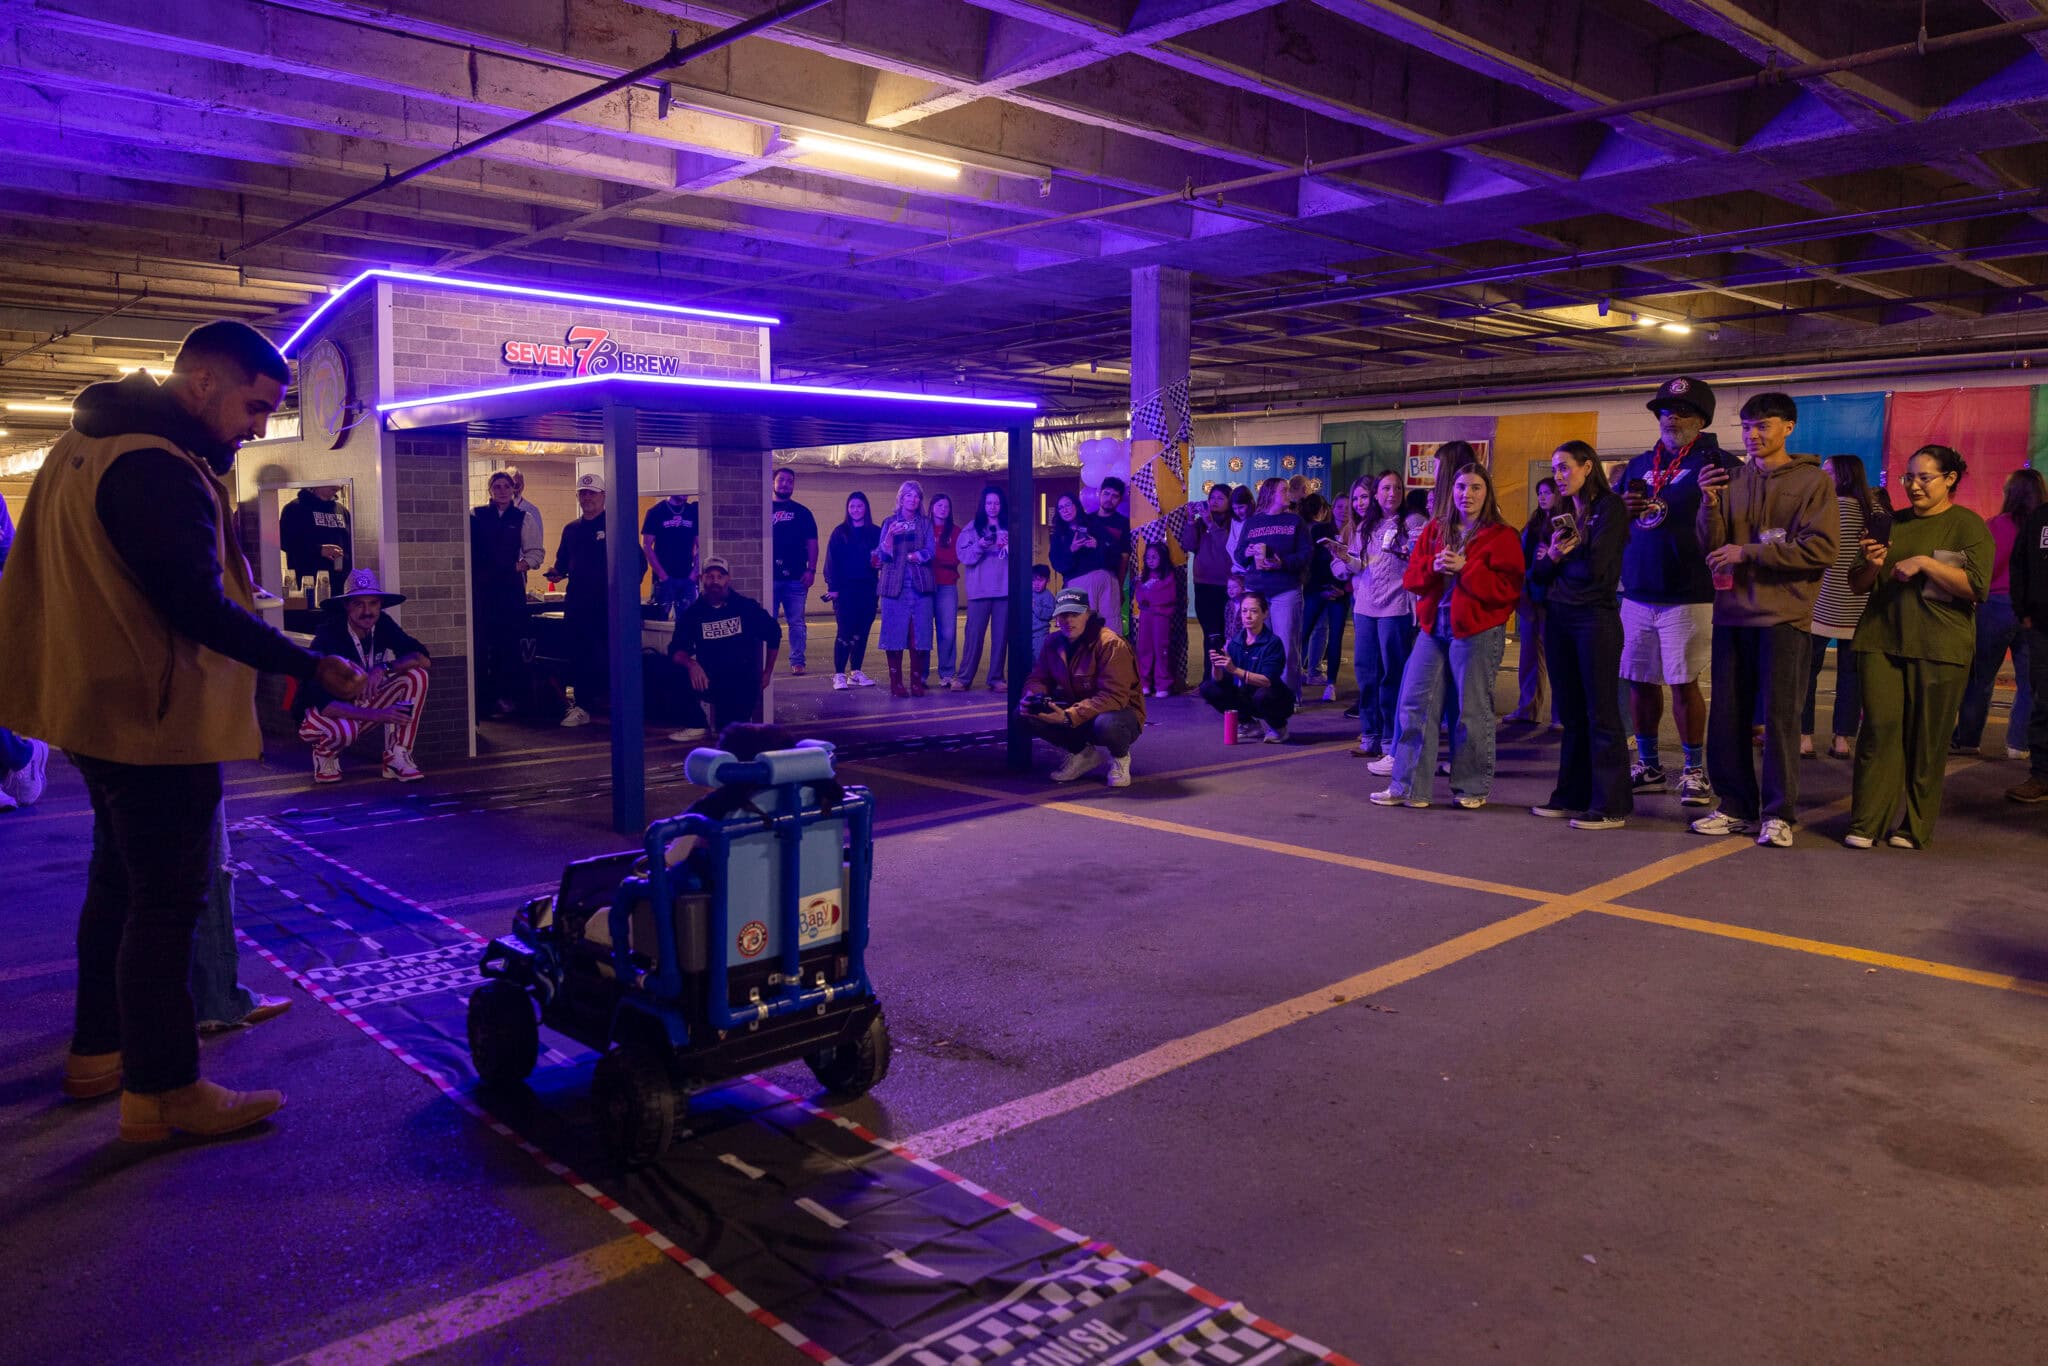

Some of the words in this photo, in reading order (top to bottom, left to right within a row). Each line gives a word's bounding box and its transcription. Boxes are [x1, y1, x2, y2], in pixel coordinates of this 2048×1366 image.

[505, 341, 574, 366] SEVEN
[622, 353, 679, 376] BREW
[1248, 525, 1295, 538] ARKANSAS
[704, 619, 740, 631] BREW
[705, 628, 739, 637] CREW
[382, 961, 456, 980] FINISH
